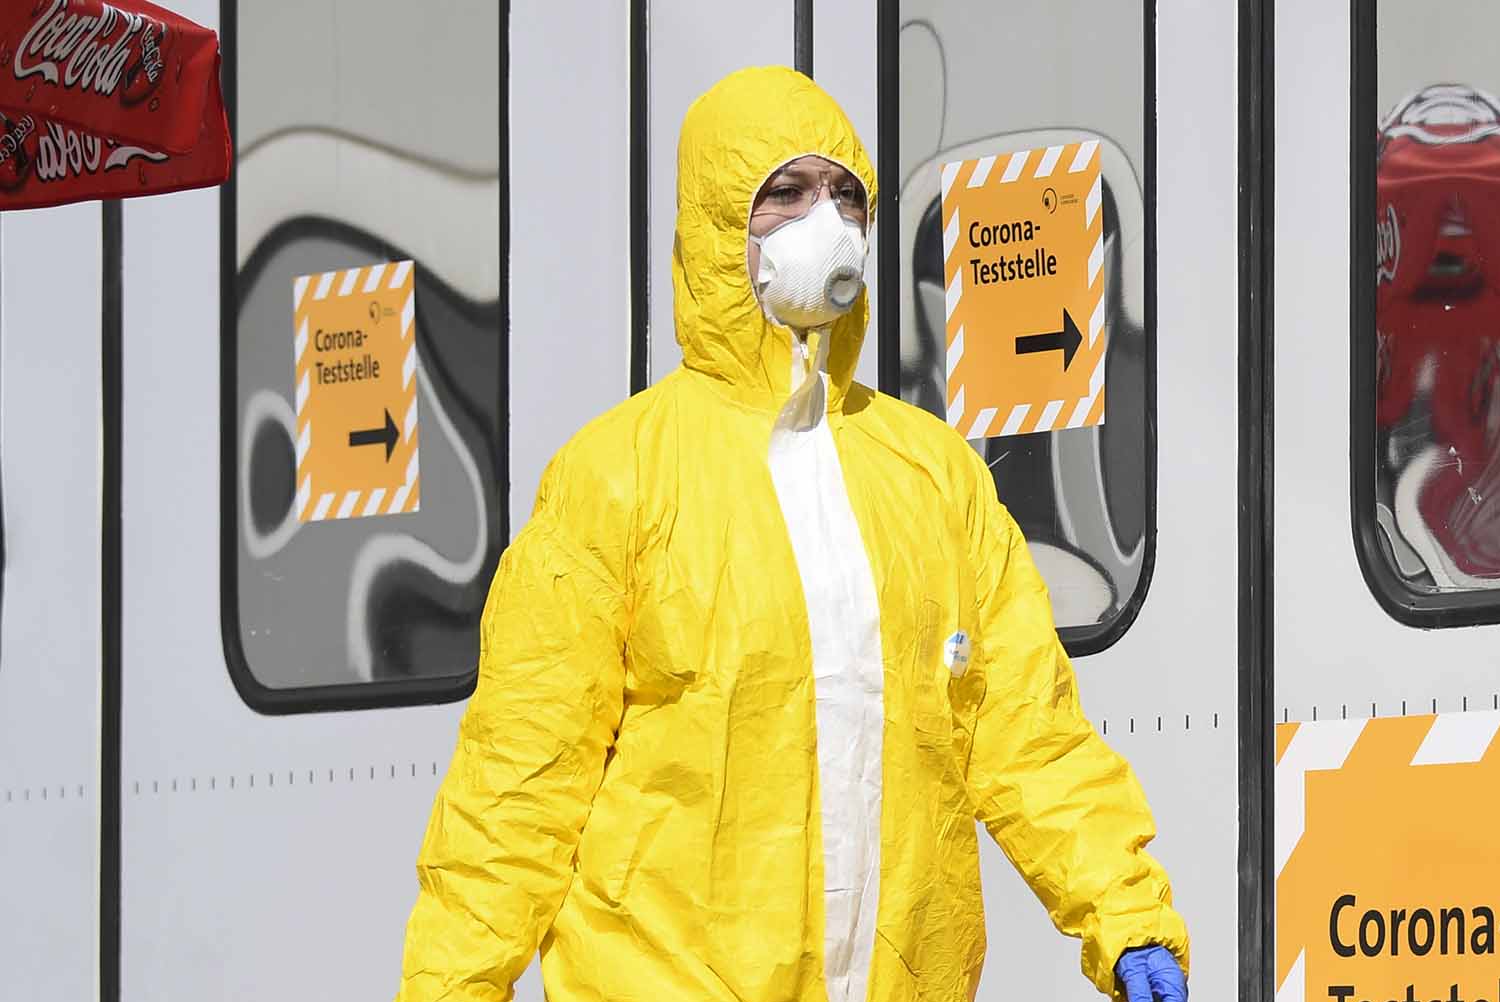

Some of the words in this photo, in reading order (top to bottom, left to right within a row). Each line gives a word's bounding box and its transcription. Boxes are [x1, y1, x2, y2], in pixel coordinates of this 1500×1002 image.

[968, 219, 1041, 248] Corona-
[970, 248, 1057, 285] Teststelle
[314, 329, 368, 352] Corona-
[315, 354, 380, 385] Teststelle
